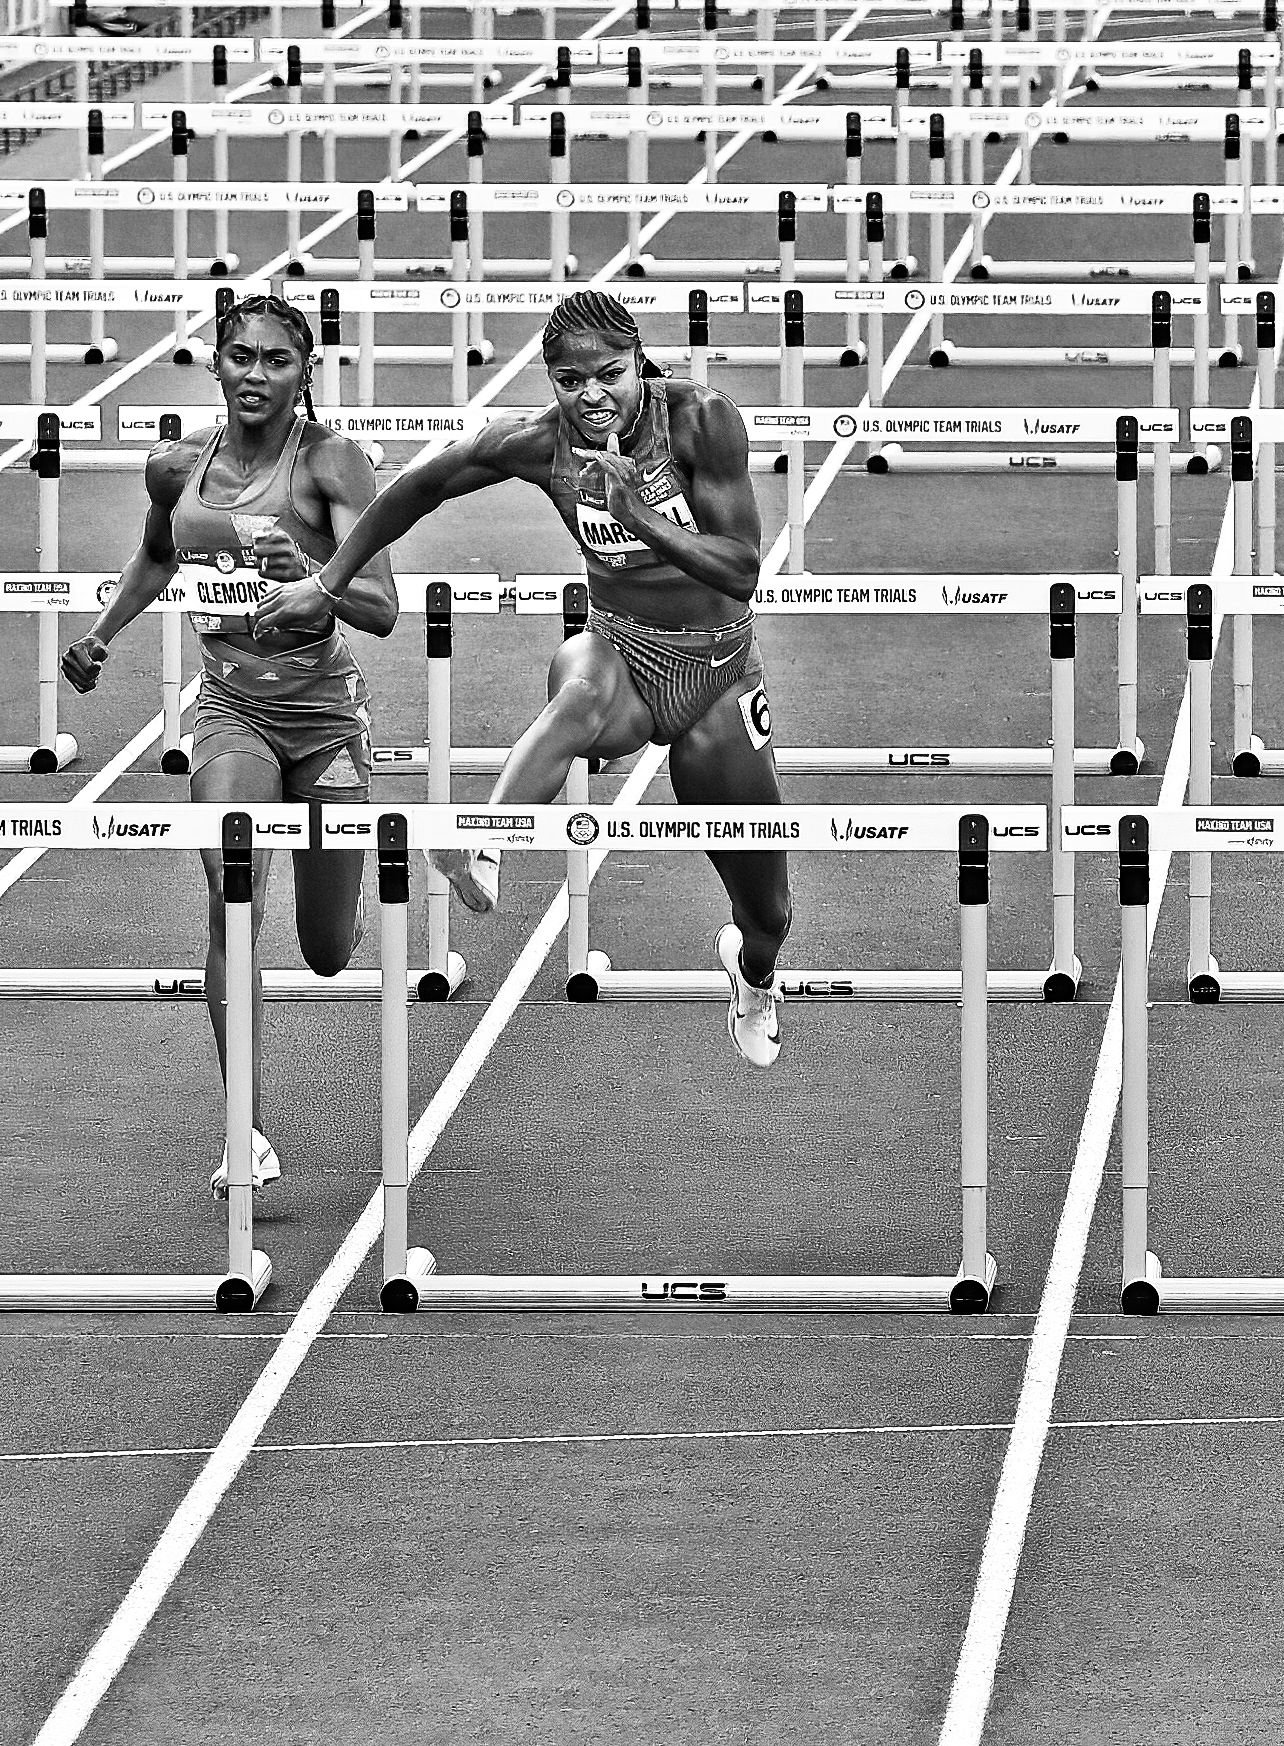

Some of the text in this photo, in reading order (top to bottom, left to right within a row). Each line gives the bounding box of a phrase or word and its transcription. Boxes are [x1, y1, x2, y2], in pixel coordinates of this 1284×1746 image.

[951, 295, 988, 305] OLYMPIC
[993, 295, 1016, 305] TEAM
[1021, 295, 1051, 305] TRIALS
[348, 419, 391, 430] OLYMPIC
[396, 419, 423, 431] TEAM
[427, 419, 463, 431] TRIALS
[863, 420, 1001, 432] U.S. OLYMPIC TEAM TRIALS
[1041, 425, 1080, 433] USATF
[1008, 457, 1057, 468] UCS
[198, 581, 268, 604] CLEMONS
[454, 592, 492, 600] UCS
[519, 592, 557, 600] UCS
[754, 588, 916, 603] U.S. OLYMPIC TEAM TRIALS
[962, 593, 1008, 603] USATF
[1078, 591, 1115, 599] UCS
[751, 688, 772, 737] 6
[373, 750, 412, 762] CS
[889, 753, 949, 766] UCS
[11, 820, 61, 836] TRIALS
[491, 816, 513, 828] TEAM
[514, 817, 533, 828] USA
[1230, 820, 1253, 831] TEAM
[1254, 820, 1272, 831] USA
[116, 824, 171, 836] USATF
[256, 824, 302, 834] UCS
[326, 824, 371, 834] UCS
[608, 821, 799, 838] U.S. OLYMPIC TEAM TRIALS
[854, 827, 909, 839] USATF
[993, 827, 1040, 837] UCS
[1065, 825, 1111, 835] UCS
[152, 979, 207, 995] UC
[780, 981, 854, 996] UCS
[640, 1283, 729, 1301] UCS
